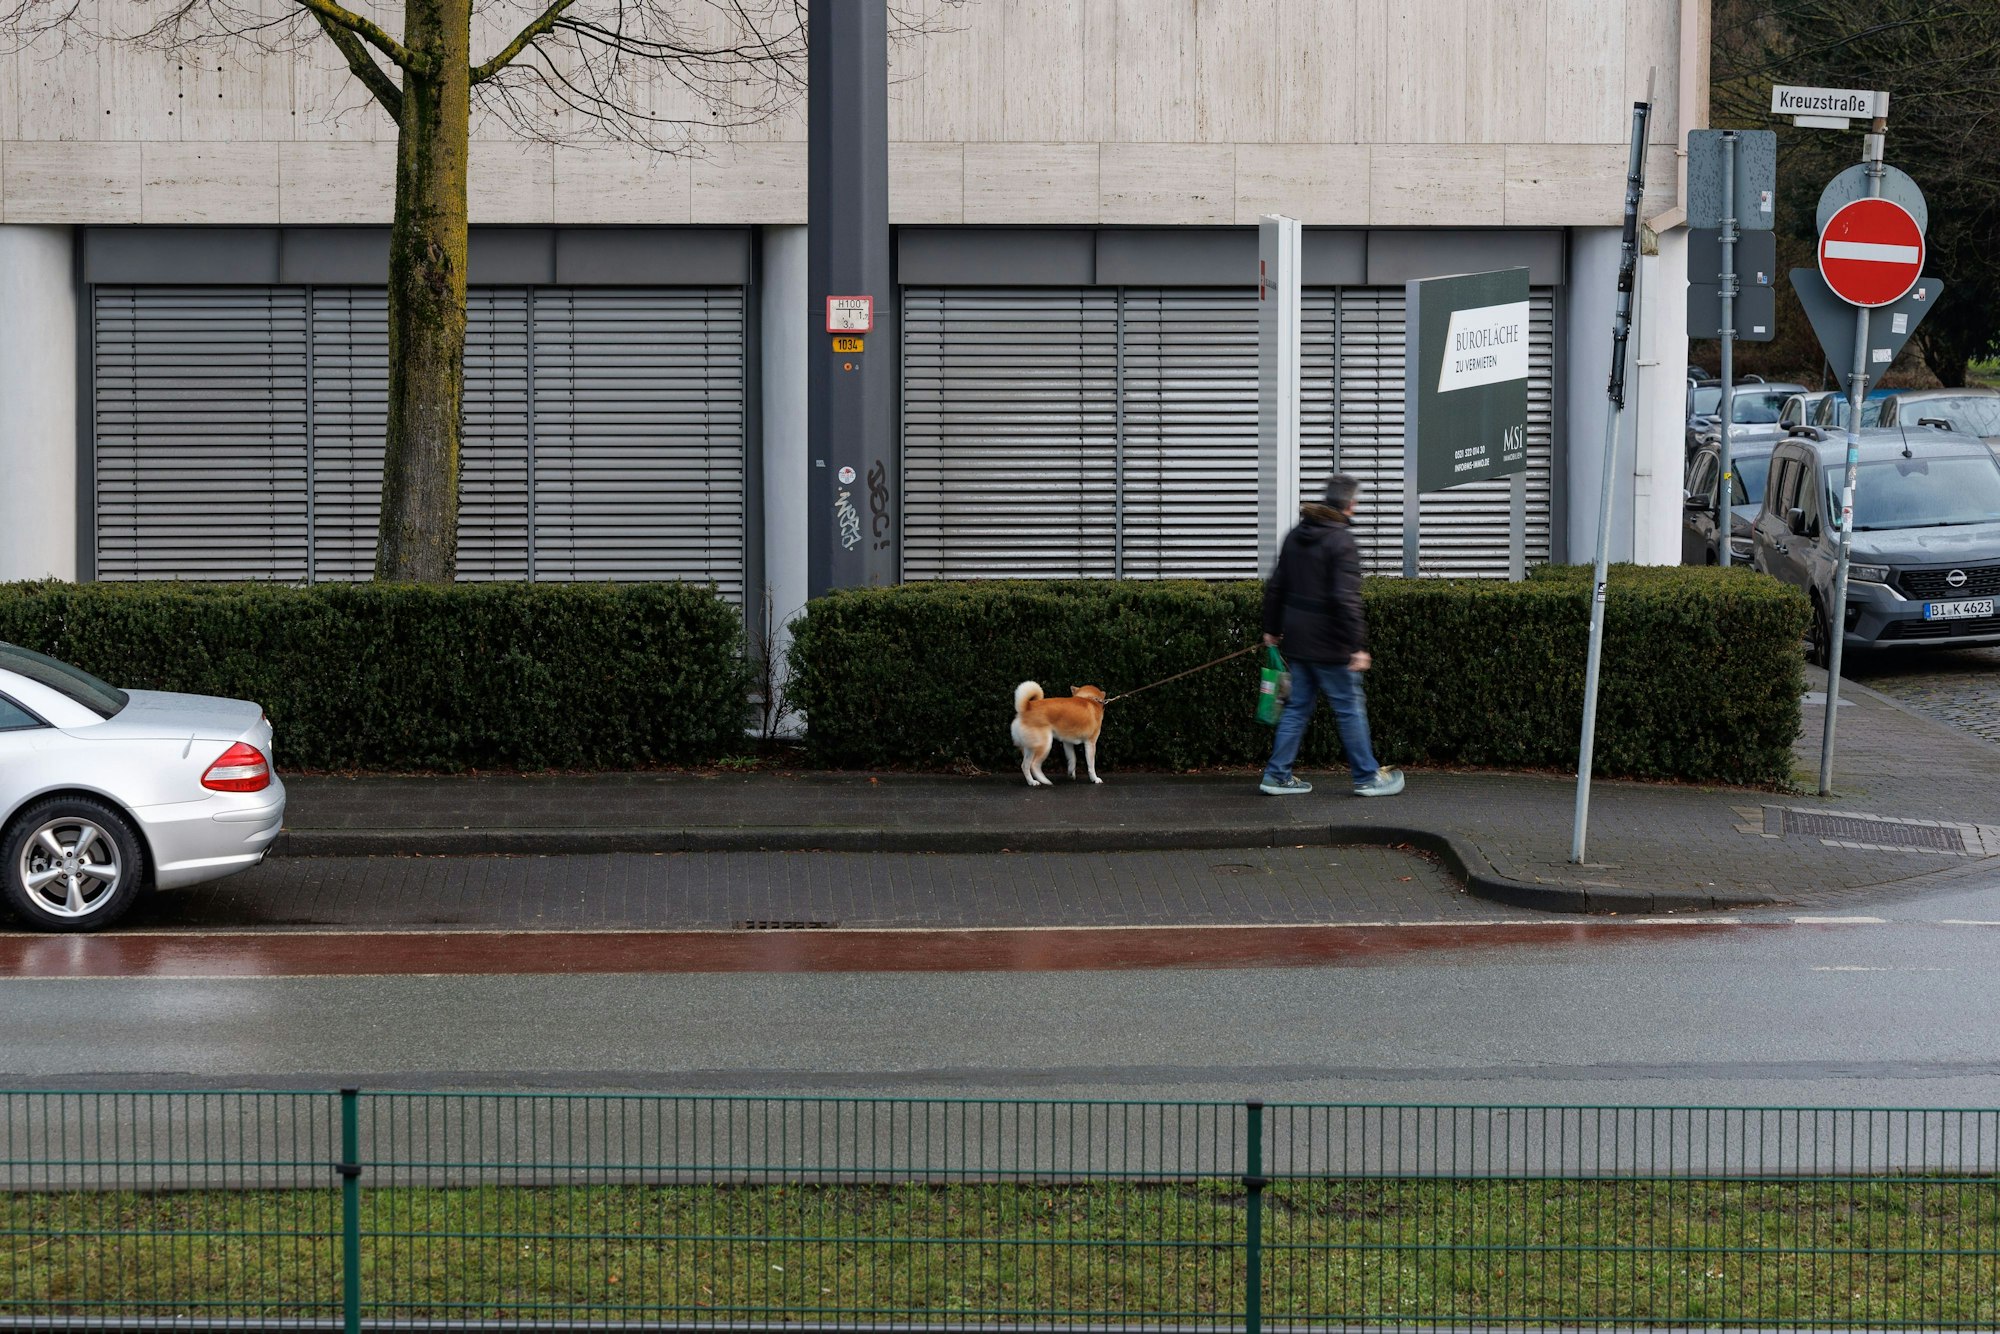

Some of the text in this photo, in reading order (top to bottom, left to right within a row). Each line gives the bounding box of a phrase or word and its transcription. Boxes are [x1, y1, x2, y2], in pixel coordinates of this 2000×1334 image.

[1780, 91, 1866, 112] Kreuzstraße
[838, 299, 861, 308] H100
[838, 339, 858, 351] 1034
[1456, 323, 1518, 351] BÜROFLÄCHE
[1456, 355, 1497, 373] ZU VERMIETEN
[1931, 601, 1992, 616] BI K 4623
